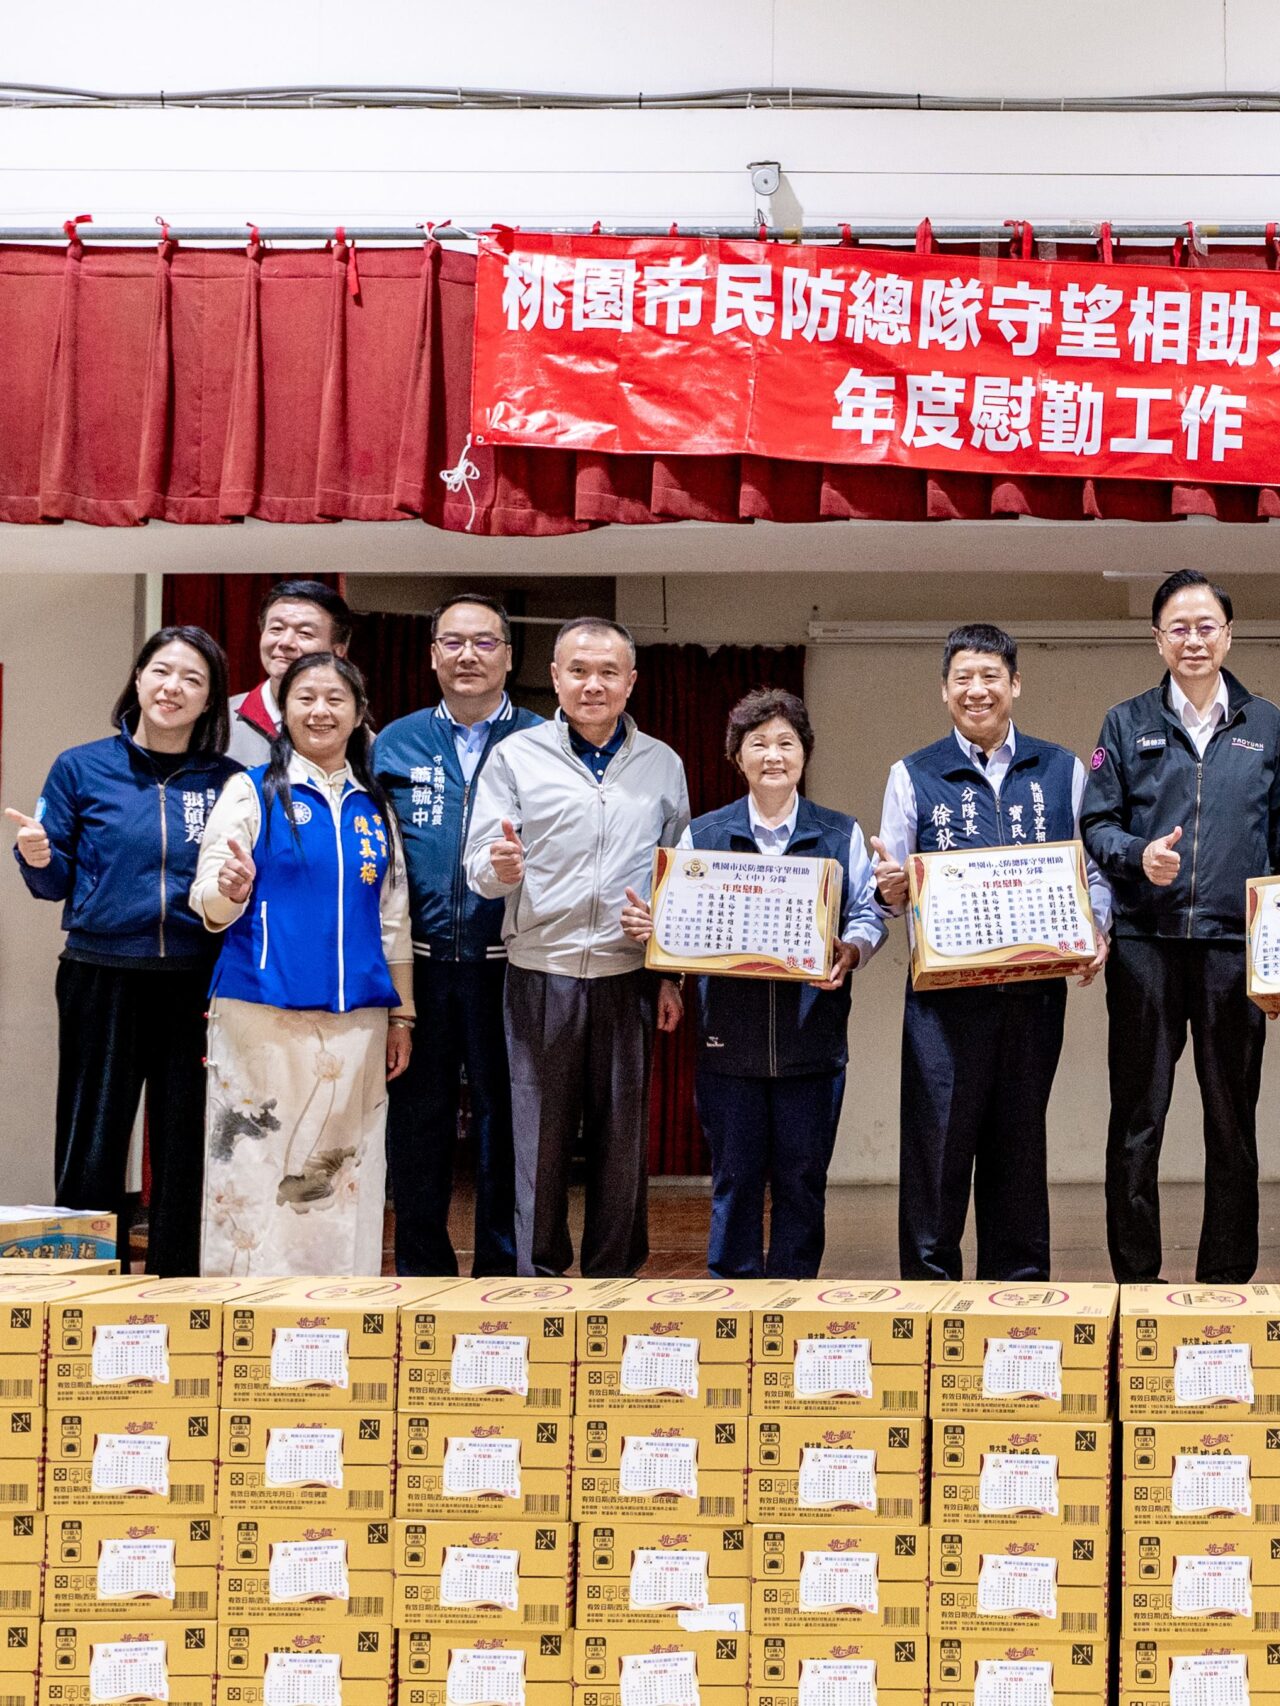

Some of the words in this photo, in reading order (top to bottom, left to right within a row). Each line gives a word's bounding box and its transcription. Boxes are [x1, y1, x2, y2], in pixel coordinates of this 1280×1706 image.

[832, 368, 1247, 462] 年度慰勤工作
[1231, 736, 1265, 749] TAOYUAN
[931, 803, 958, 852] 徐秋
[961, 786, 980, 837] 分隊長
[1008, 804, 1027, 847] 寶民
[712, 862, 810, 876] 桃園市民防總隊守望相助
[722, 884, 763, 894] 年度慰勤
